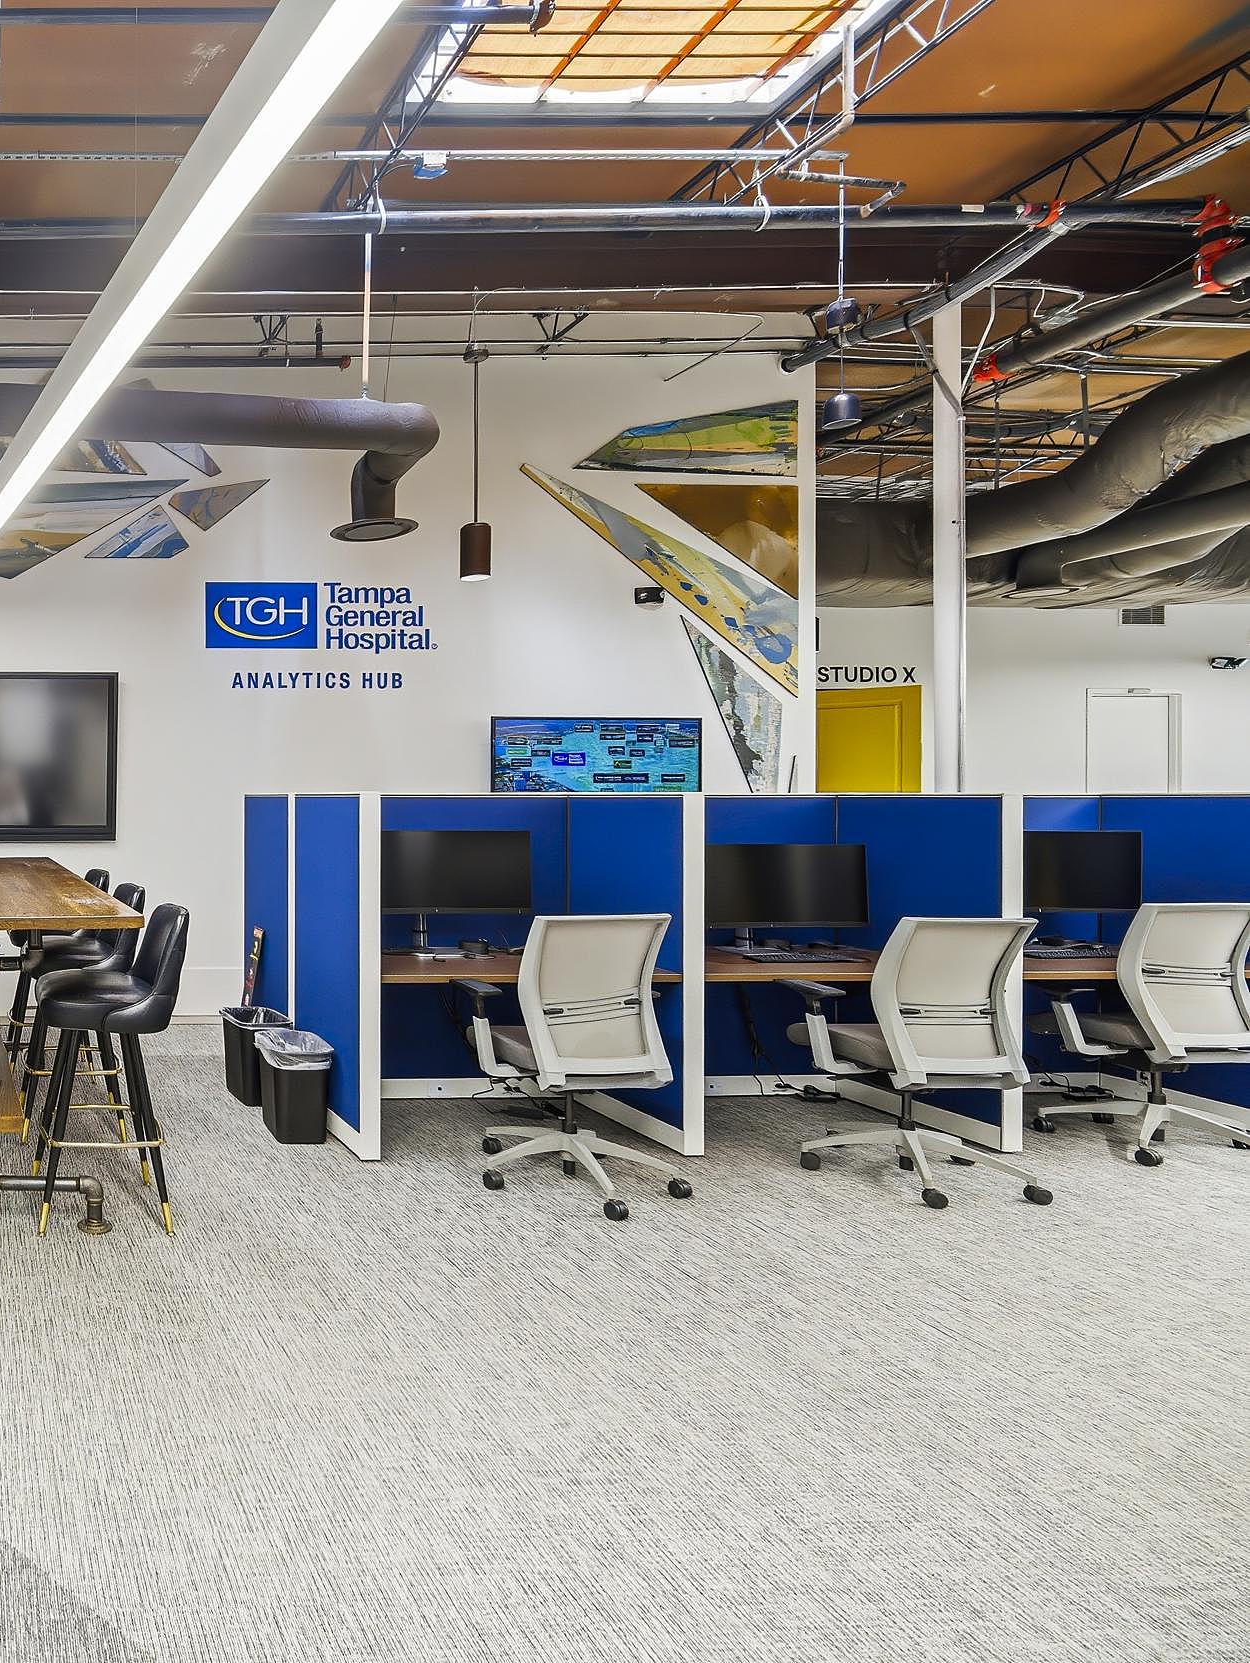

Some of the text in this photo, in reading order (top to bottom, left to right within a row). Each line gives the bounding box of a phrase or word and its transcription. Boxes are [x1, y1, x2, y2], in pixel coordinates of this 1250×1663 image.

[324, 583, 412, 608] Tampa
[226, 597, 308, 626] TGH
[325, 605, 423, 627] General
[231, 672, 403, 689] ANALYTICS HUB
[817, 666, 916, 683] STUDIO X
